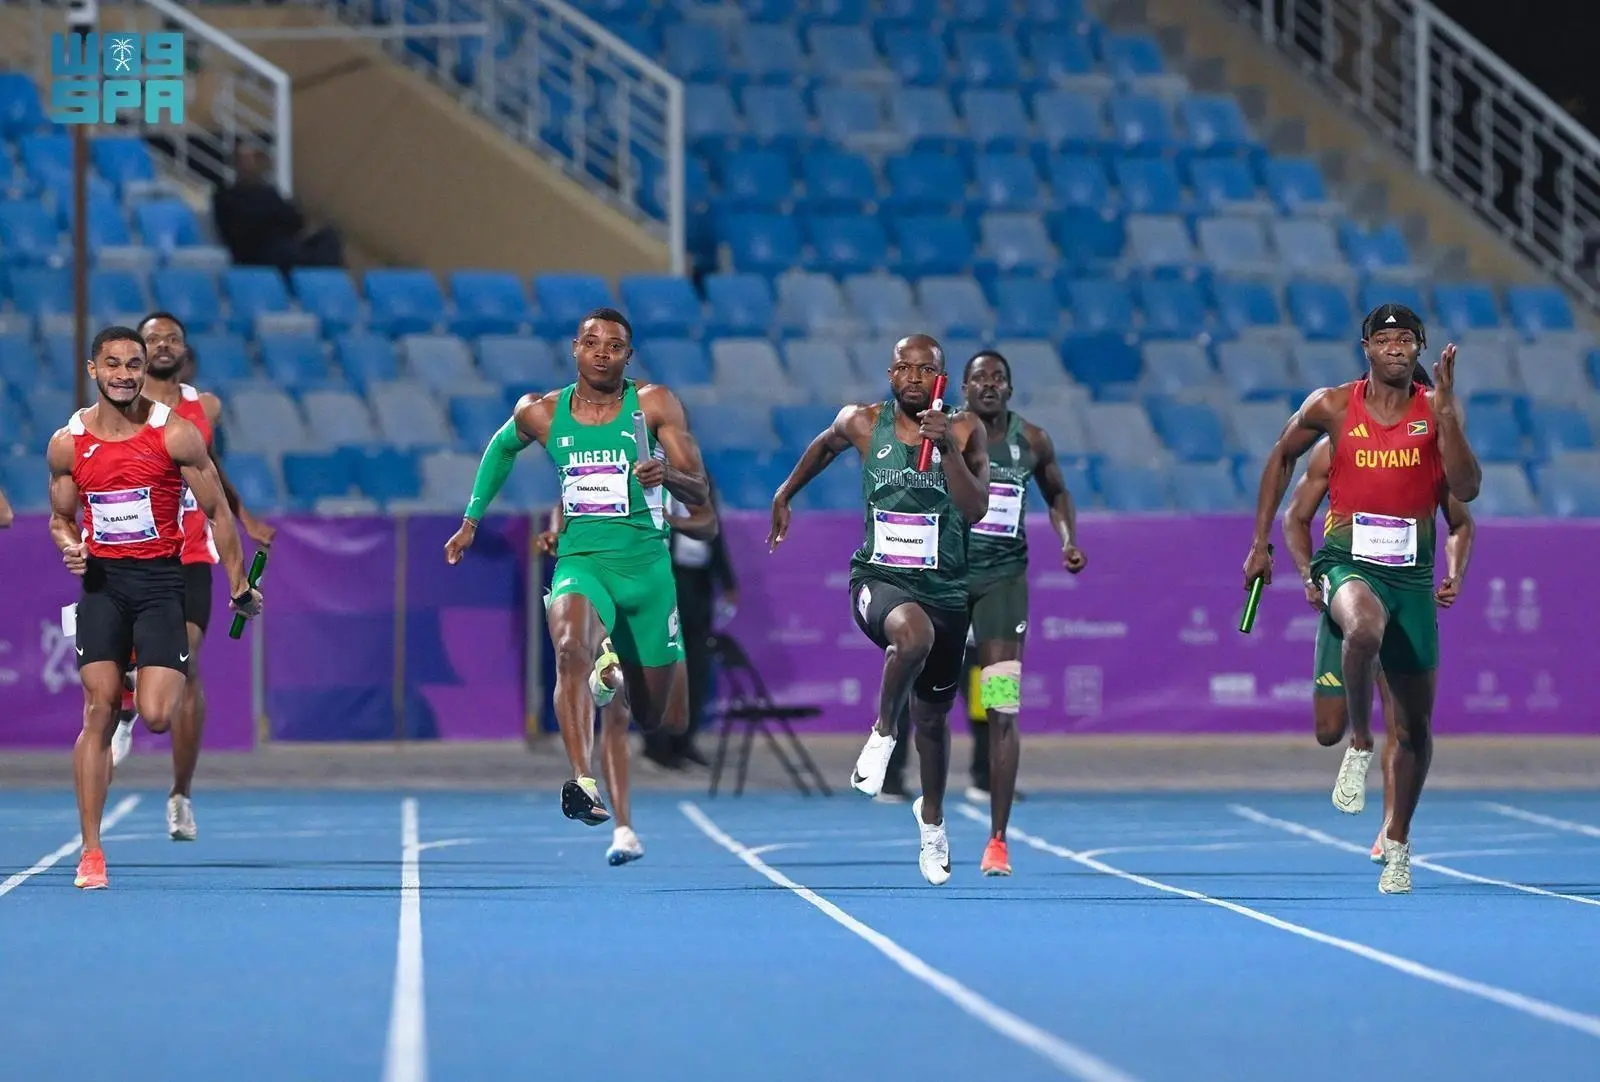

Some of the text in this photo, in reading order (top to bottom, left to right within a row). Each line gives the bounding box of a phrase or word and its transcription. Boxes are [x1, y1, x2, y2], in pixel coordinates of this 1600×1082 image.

[568, 448, 628, 465] NIGERIA
[1355, 447, 1421, 468] GUYANA
[874, 467, 906, 487] SAUDI
[110, 514, 139, 523] BALUSHI
[885, 536, 924, 545] MOHAMMED
